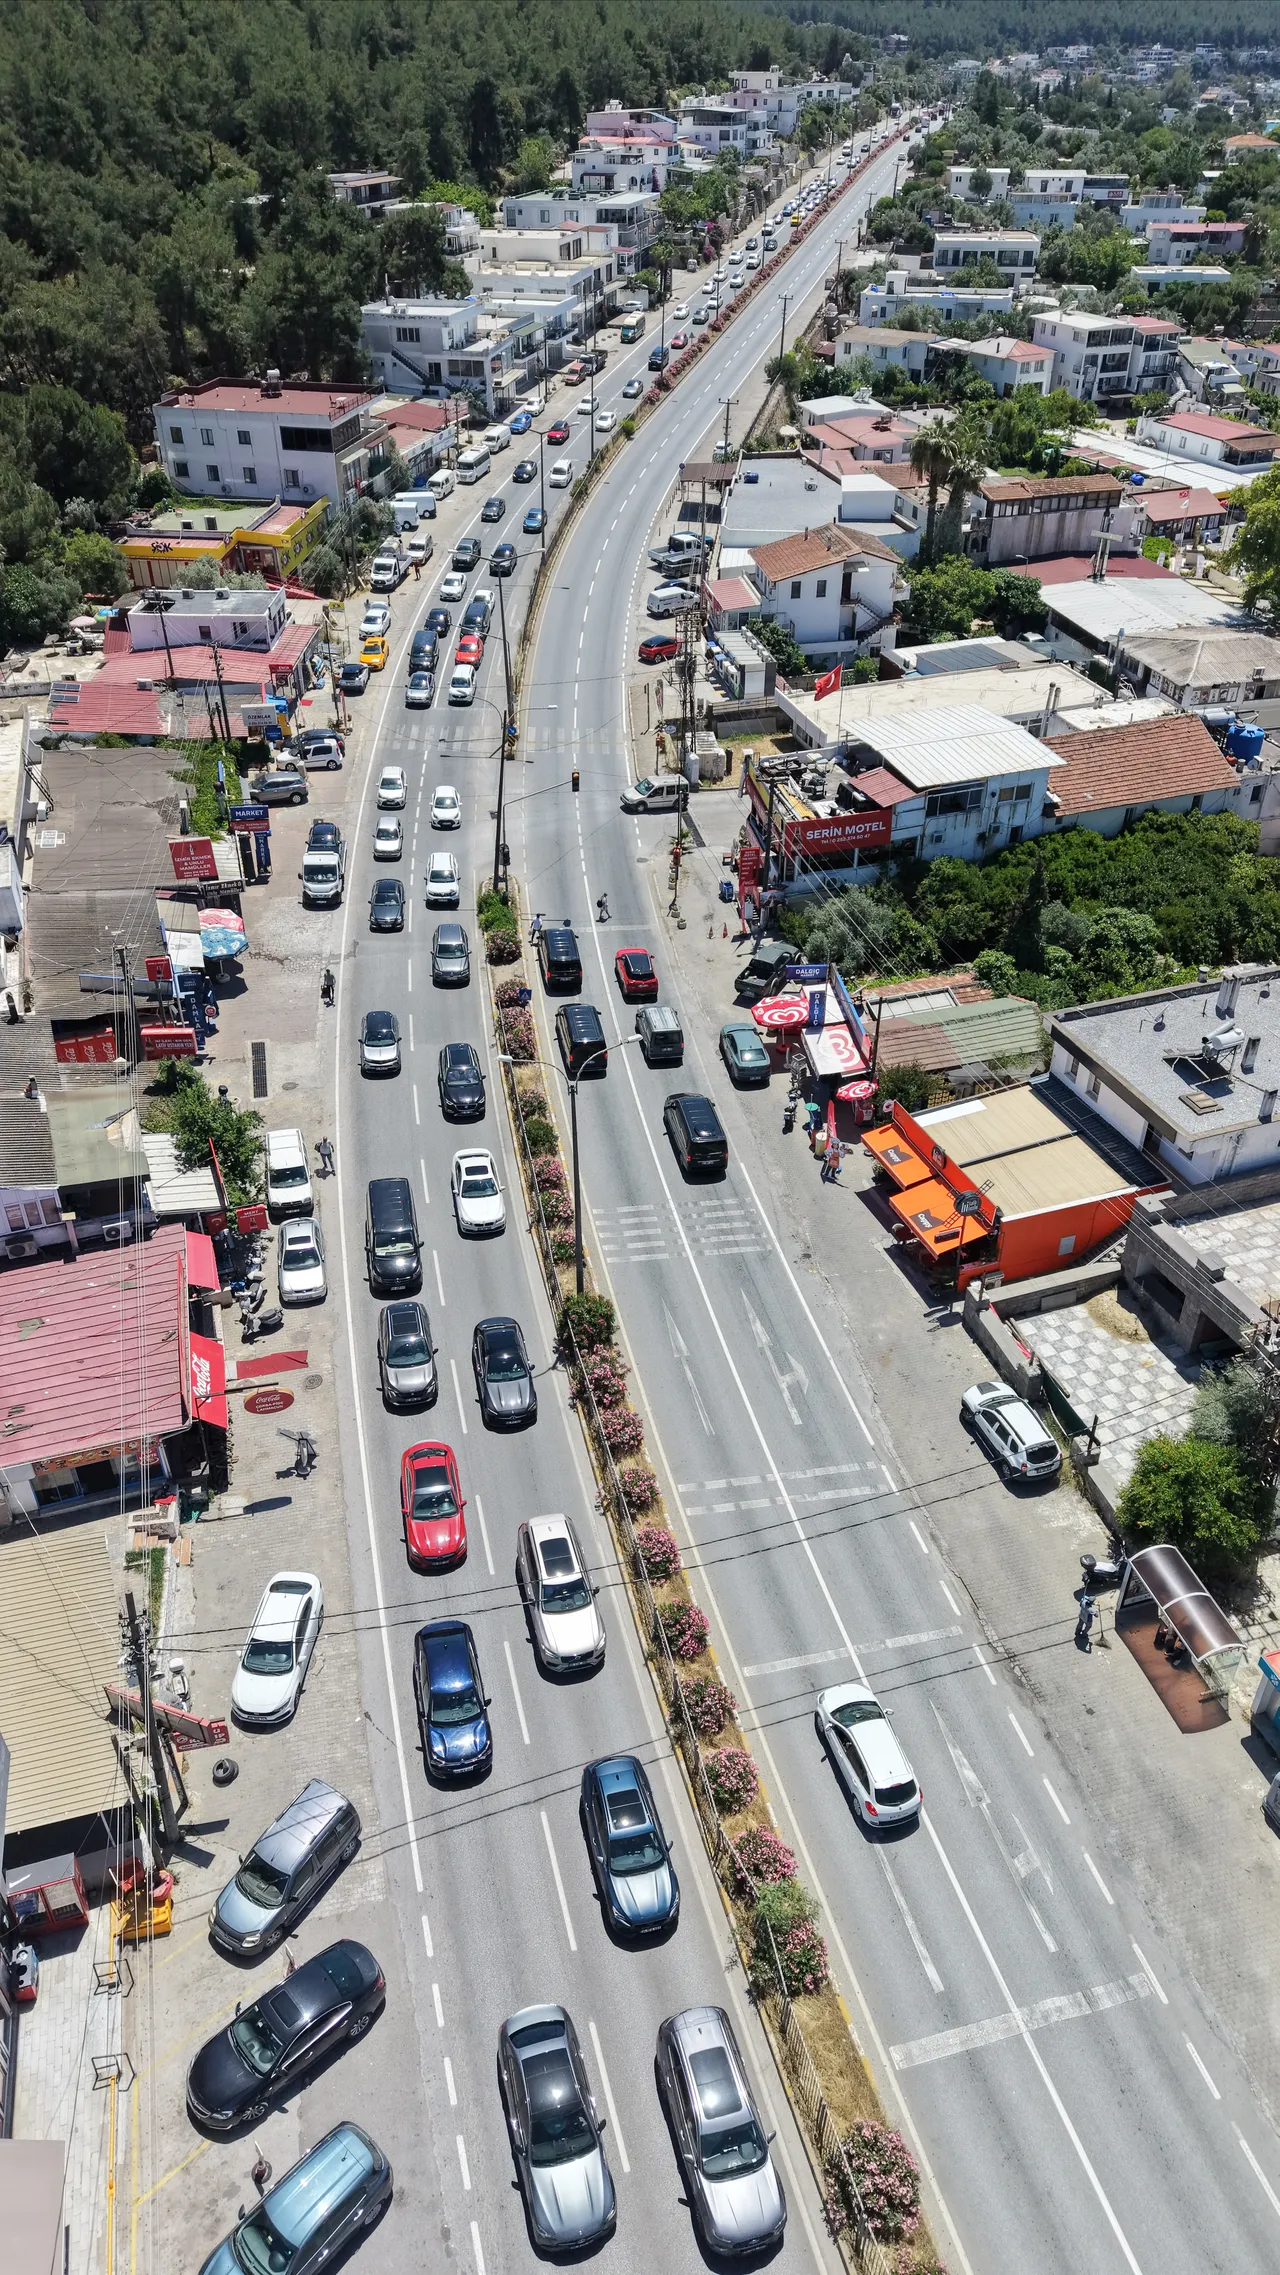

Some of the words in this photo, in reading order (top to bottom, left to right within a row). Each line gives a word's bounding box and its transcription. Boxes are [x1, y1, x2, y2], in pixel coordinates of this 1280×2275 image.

[806, 826, 842, 840] SERİN
[845, 821, 886, 835] MOTEL
[190, 997, 202, 1029] DAMLA
[887, 1149, 902, 1163] Cappy
[917, 1213, 933, 1229] Cappy
